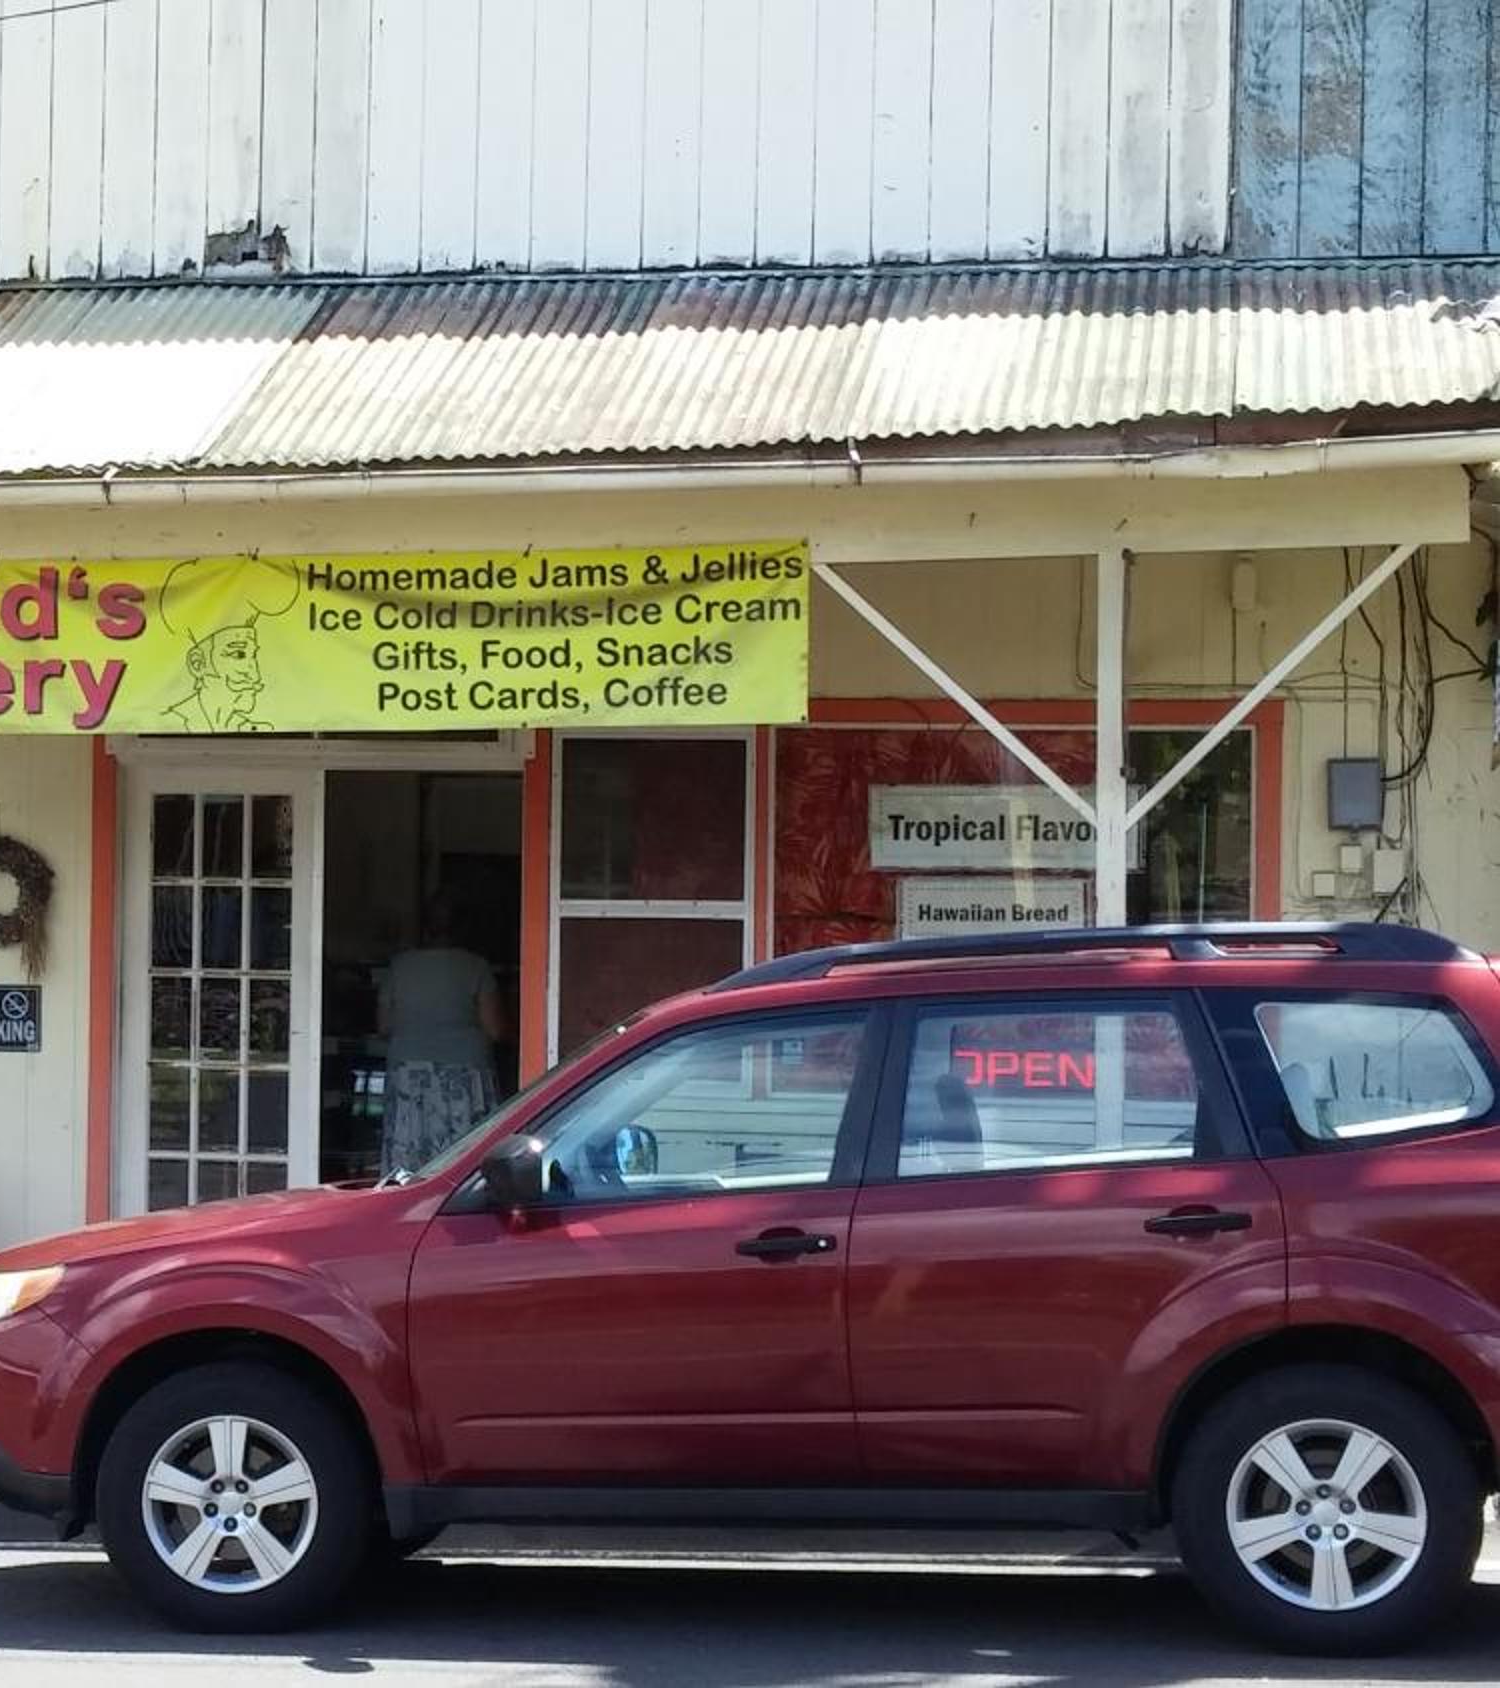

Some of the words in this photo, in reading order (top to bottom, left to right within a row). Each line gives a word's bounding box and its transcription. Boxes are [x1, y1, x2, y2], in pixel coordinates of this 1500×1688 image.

[307, 560, 517, 592] Homemade
[528, 557, 628, 588] Jams
[641, 555, 669, 585] &
[680, 552, 803, 584] Jellies
[308, 603, 362, 632] Ice
[373, 600, 457, 631] Cold
[674, 594, 801, 626] Cream
[372, 641, 468, 672] Gifts,
[480, 638, 584, 672] Food,
[596, 636, 733, 668] Snacks
[377, 681, 458, 712] Post
[468, 680, 589, 712] Cards,
[603, 677, 728, 708] Coffee
[888, 814, 1005, 846] Tropical
[1015, 814, 1098, 843] Flavo
[918, 904, 1006, 922] Hawaiian
[1012, 904, 1069, 922] Bread
